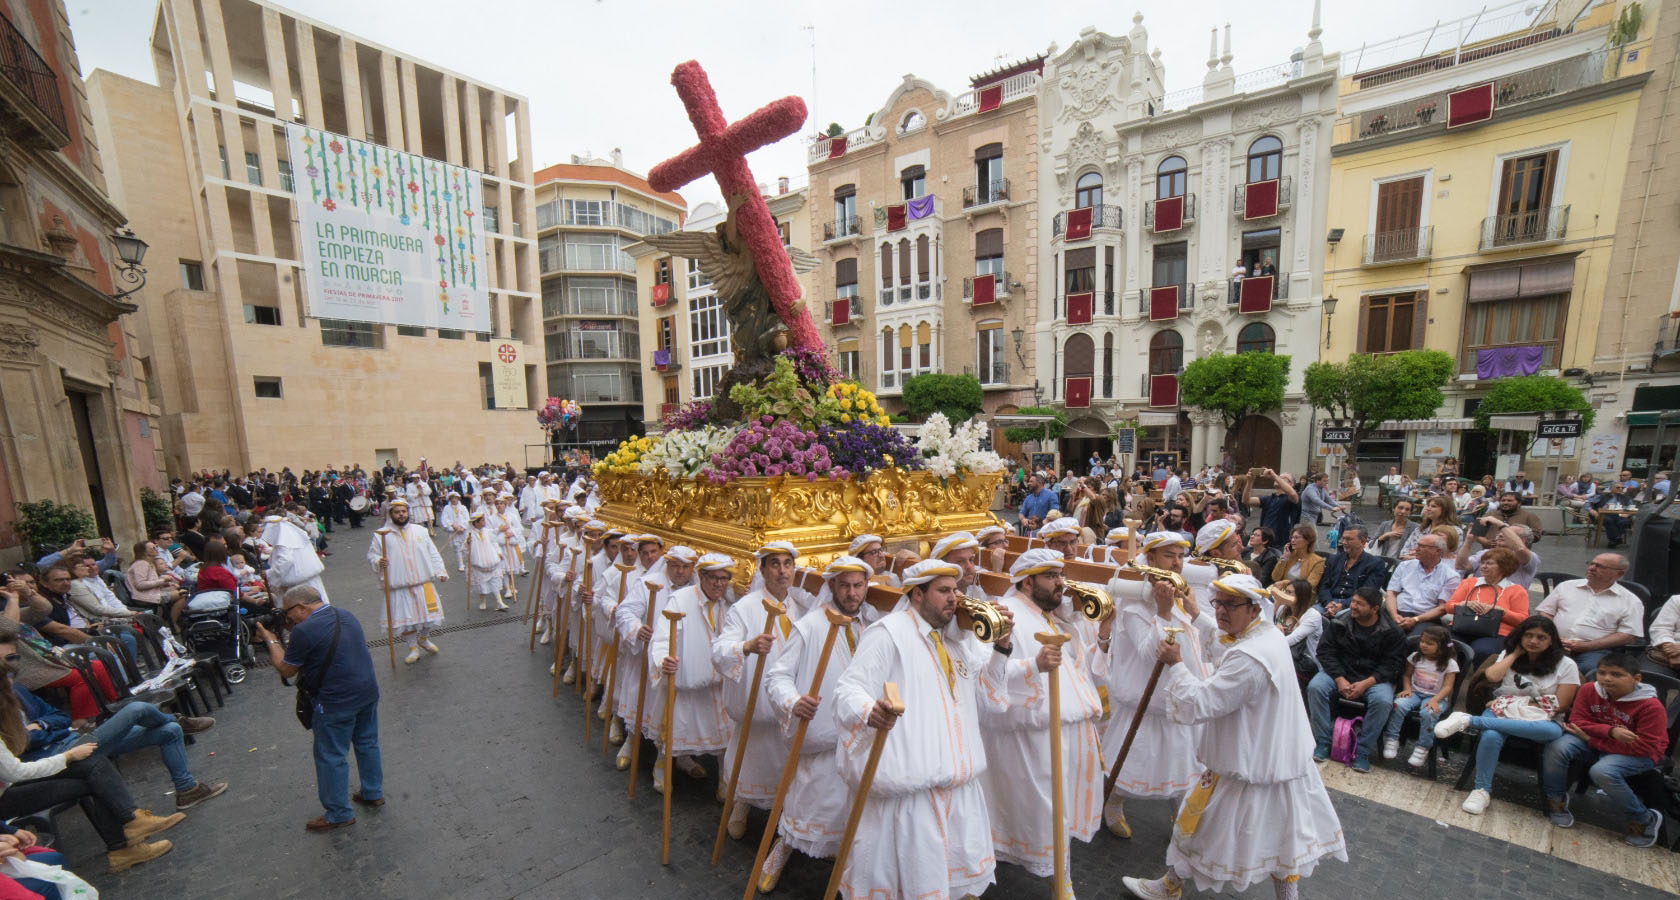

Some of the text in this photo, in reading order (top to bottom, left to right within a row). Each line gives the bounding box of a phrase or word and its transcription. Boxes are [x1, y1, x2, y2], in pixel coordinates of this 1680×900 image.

[316, 221, 424, 254] LA PRIMAVERA
[318, 240, 384, 265] EMPIEZA
[321, 260, 402, 286] EN MURCIA
